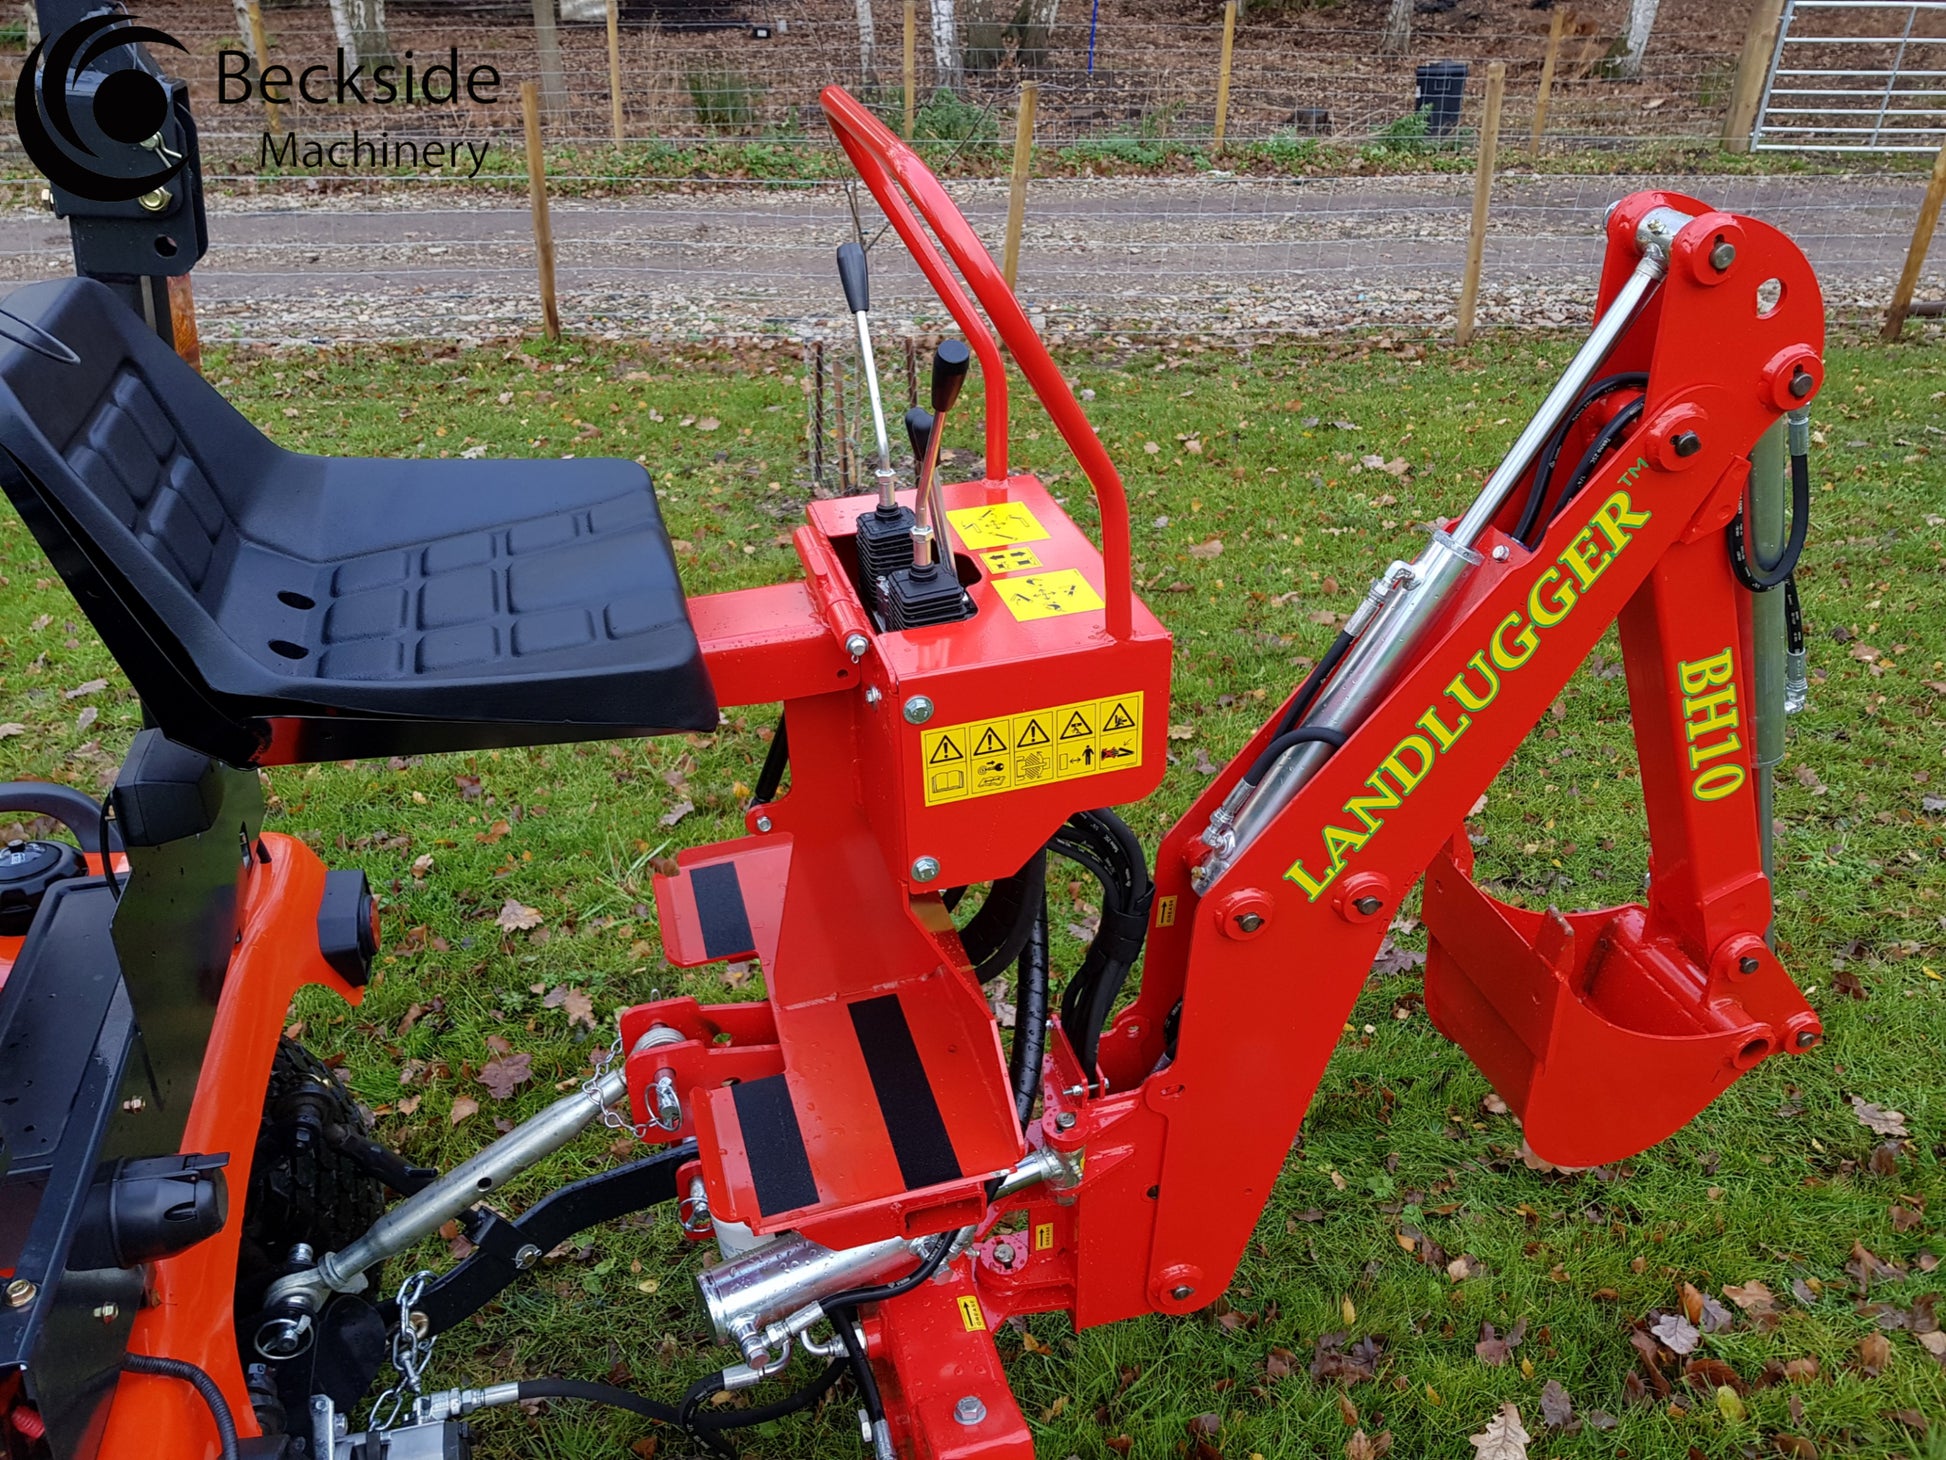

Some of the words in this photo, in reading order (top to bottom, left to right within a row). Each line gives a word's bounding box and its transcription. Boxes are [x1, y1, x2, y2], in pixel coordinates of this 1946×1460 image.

[1283, 490, 1652, 903] LANDLUGGER
[1678, 647, 1745, 802] BH10
[1166, 900, 1174, 922] GREASE
[970, 1299, 981, 1326] GREASE
